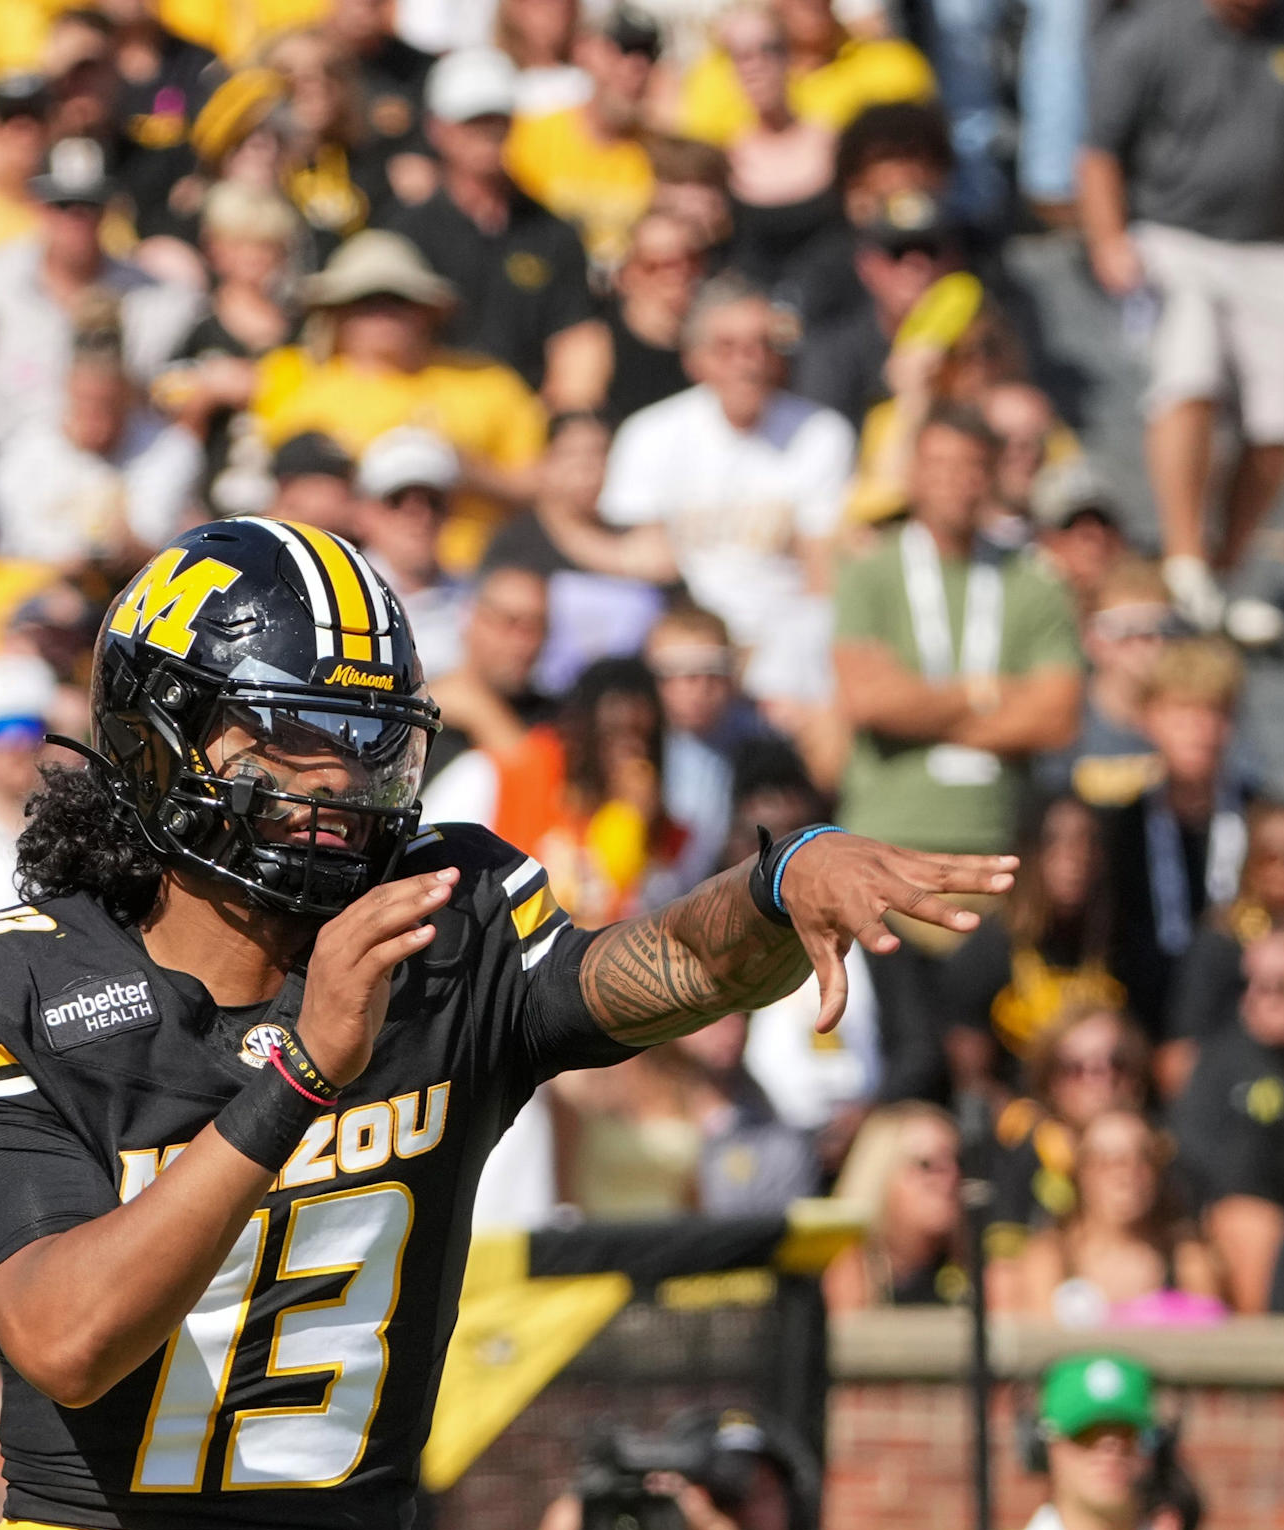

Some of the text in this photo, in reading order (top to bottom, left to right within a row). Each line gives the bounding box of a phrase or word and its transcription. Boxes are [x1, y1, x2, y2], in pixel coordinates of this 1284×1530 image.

[108, 547, 243, 660] M
[324, 664, 394, 691] Missouri
[44, 981, 148, 1026] ambetter
[85, 1002, 153, 1032] HEALTH
[119, 1080, 451, 1205] MZOU
[130, 1180, 415, 1493] 13
